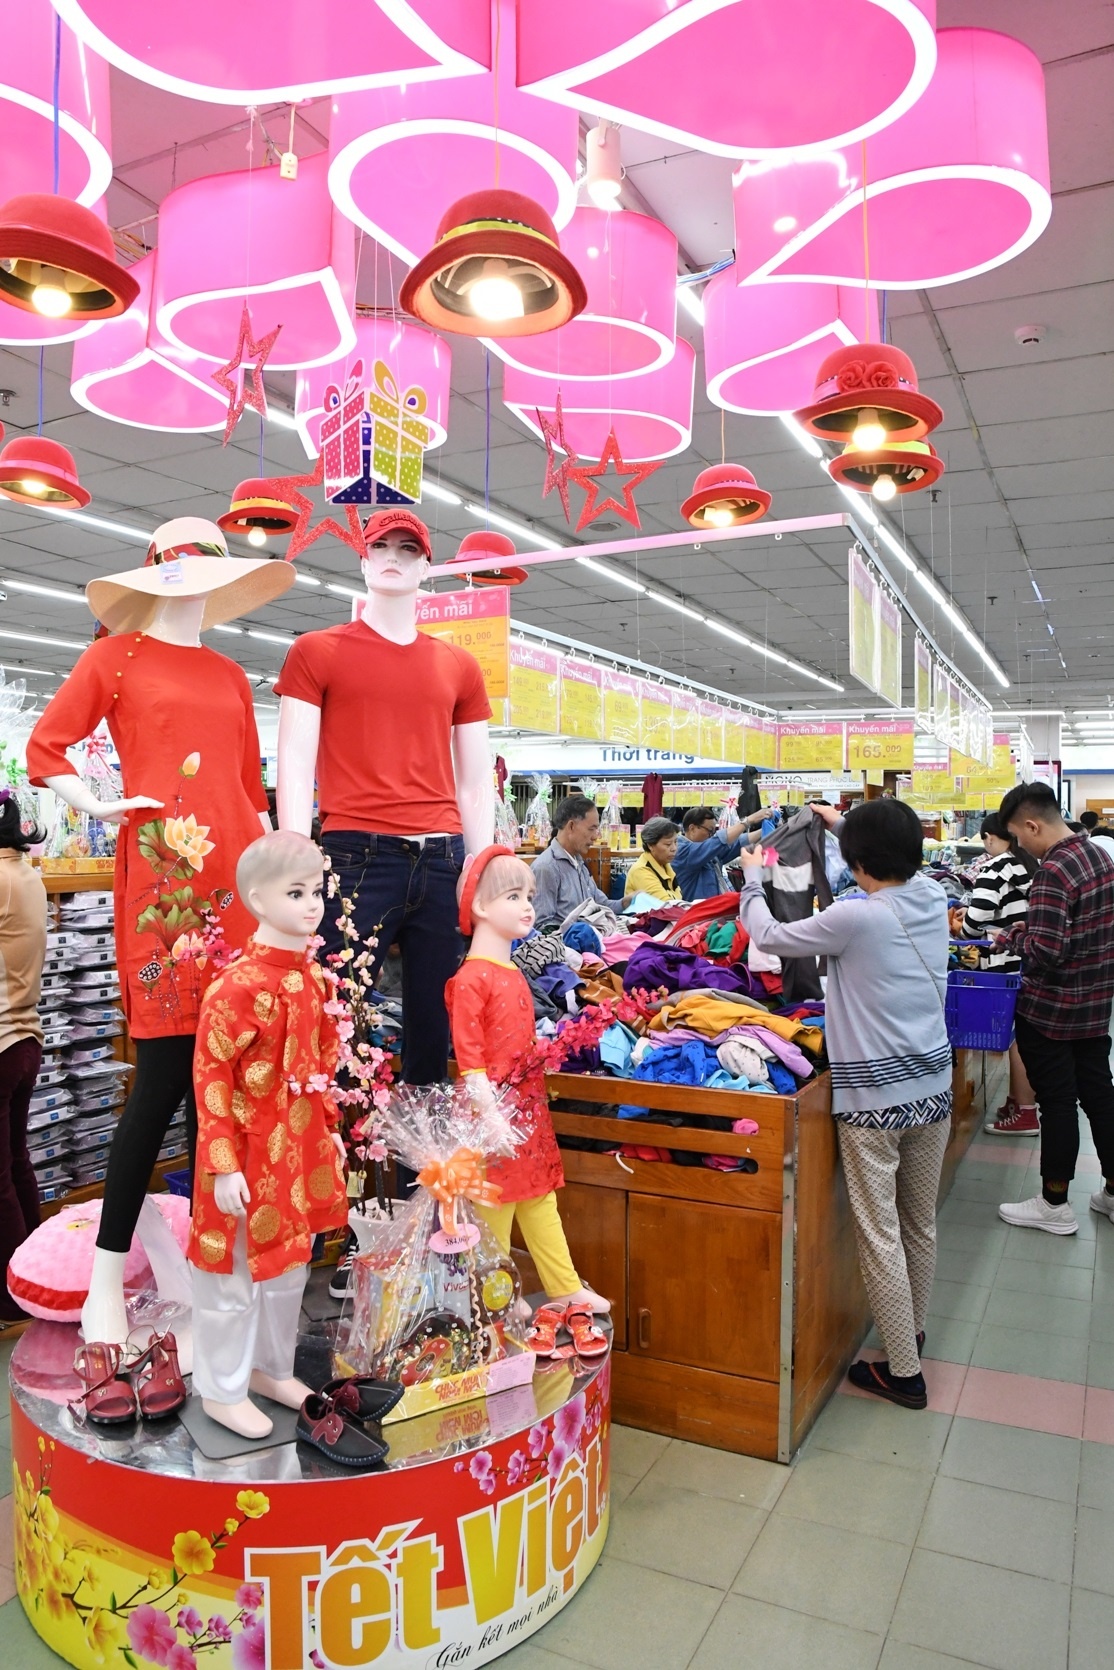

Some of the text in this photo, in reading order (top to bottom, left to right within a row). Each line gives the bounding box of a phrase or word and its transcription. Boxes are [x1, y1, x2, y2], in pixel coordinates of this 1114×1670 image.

[245, 1437, 601, 1670] Tết Việt
[430, 1584, 559, 1670] Gắn kết mọi nhà
